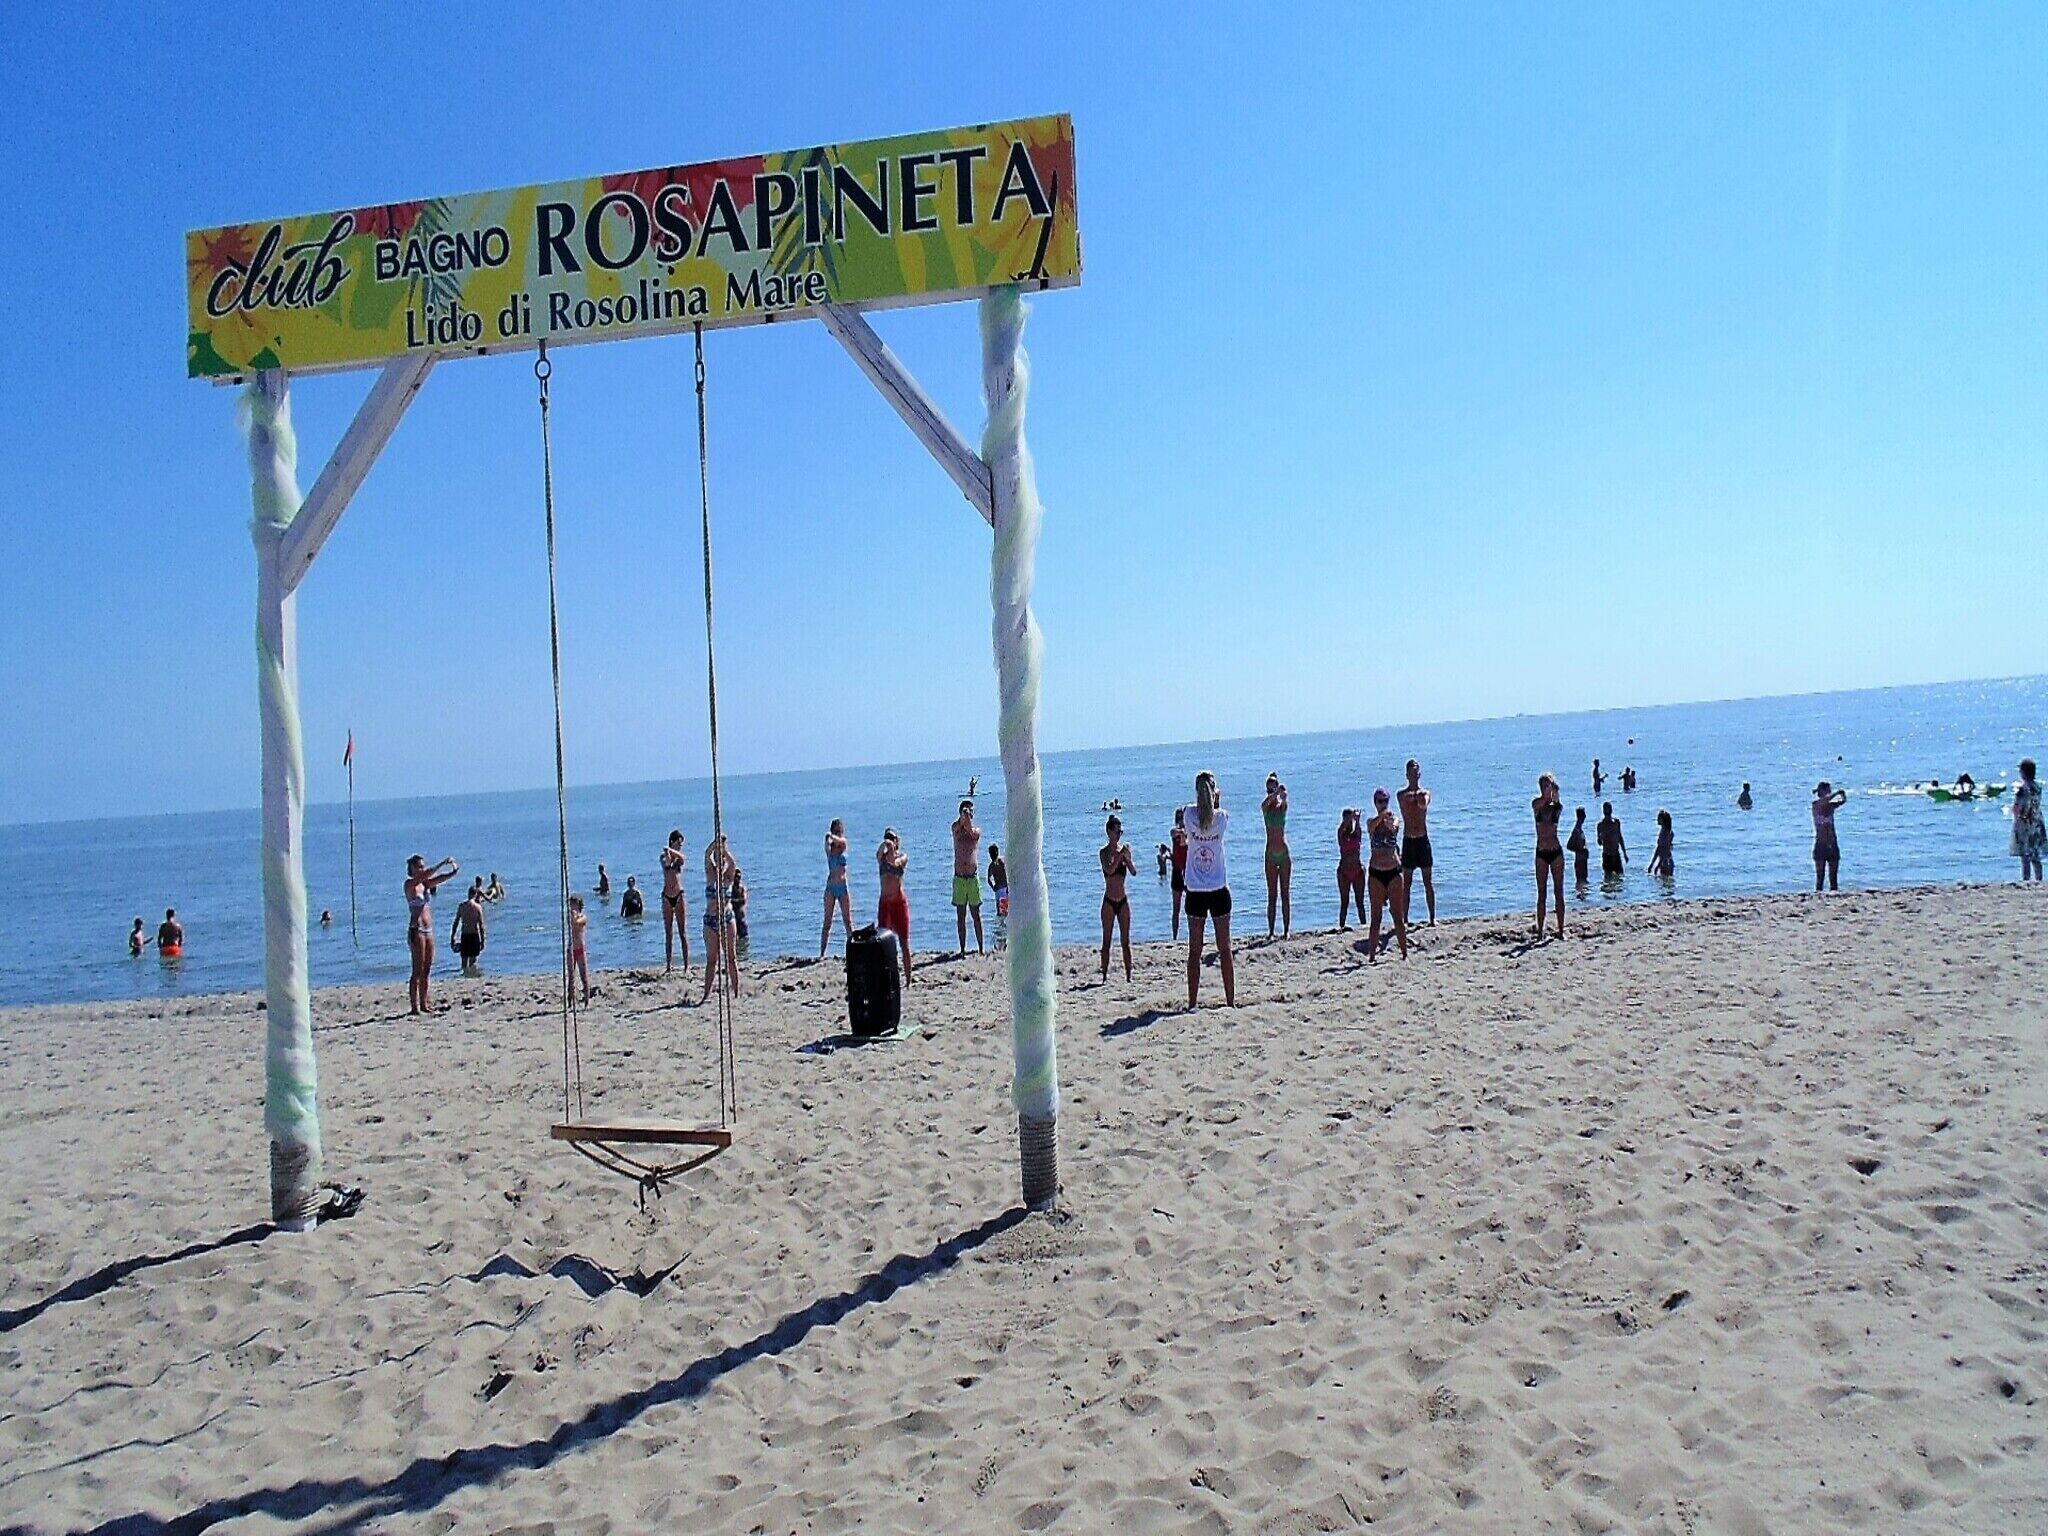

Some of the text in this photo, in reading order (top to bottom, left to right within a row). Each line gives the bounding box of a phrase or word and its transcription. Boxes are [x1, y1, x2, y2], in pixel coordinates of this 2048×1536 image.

[207, 142, 1051, 317] club BAGNO ROSAPINETA
[406, 268, 825, 348] Lido di Rosolina Mare
